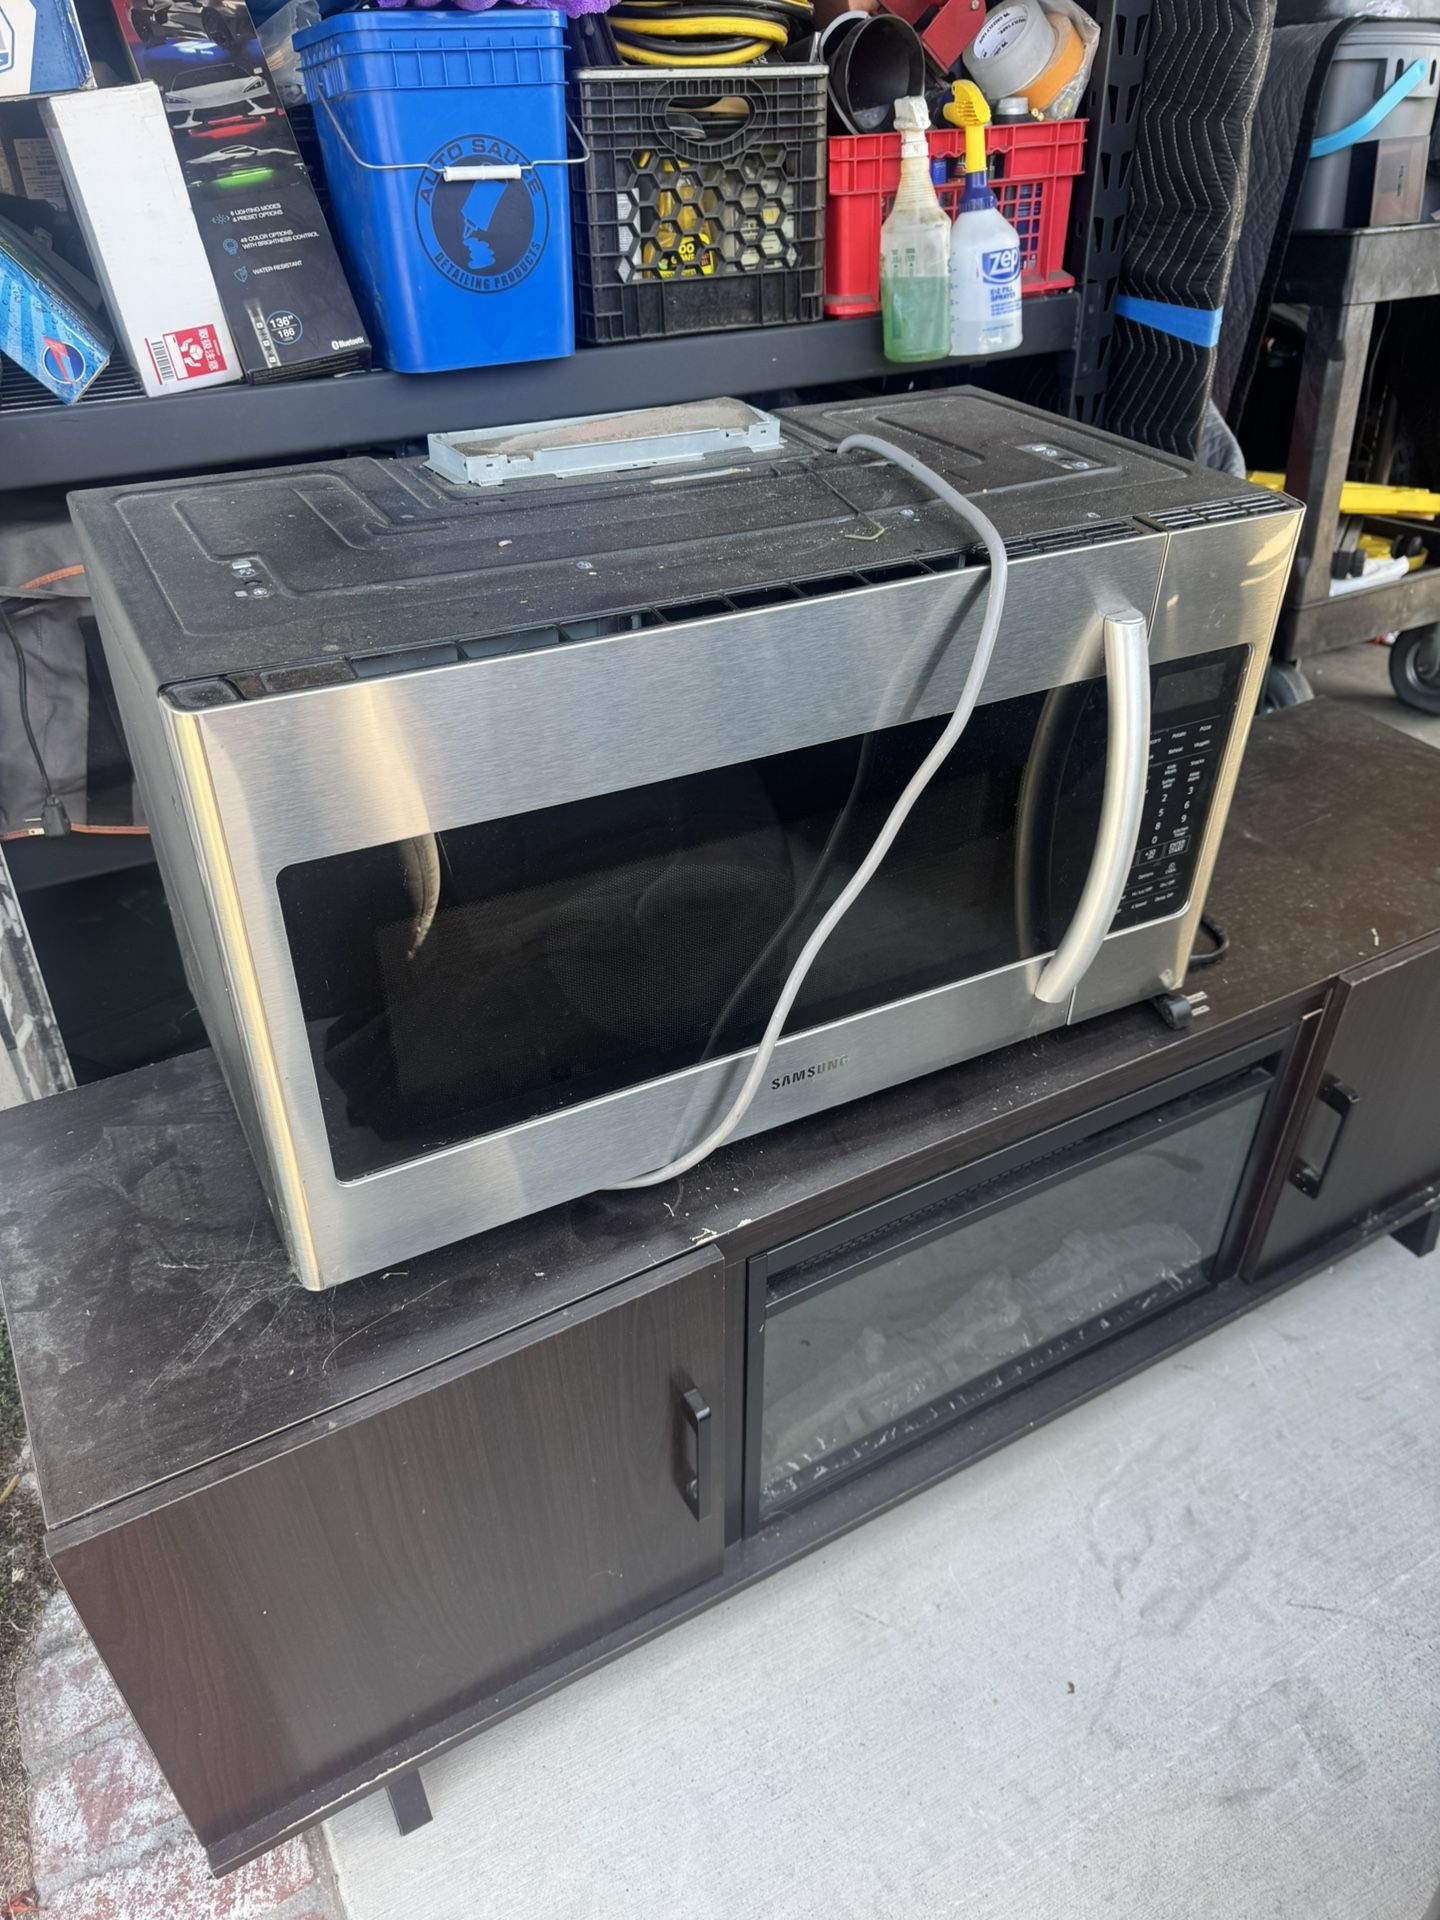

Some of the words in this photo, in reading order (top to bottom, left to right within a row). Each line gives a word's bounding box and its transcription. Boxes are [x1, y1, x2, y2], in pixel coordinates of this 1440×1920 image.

[421, 143, 463, 206] AUTO
[269, 229, 293, 238] OPTIONS
[293, 231, 319, 240] CONTROL
[494, 241, 541, 288] PRODUCTS
[434, 251, 490, 289] DETAILING
[270, 315, 294, 329] 136"
[1187, 786, 1194, 795] 3
[1161, 793, 1168, 802] 2
[1184, 800, 1190, 809] 6
[1158, 808, 1164, 817] 5
[1181, 814, 1187, 823] 9
[1154, 822, 1161, 831] 8
[1151, 835, 1158, 844] 0
[770, 1055, 849, 1090] SAMSUNG
